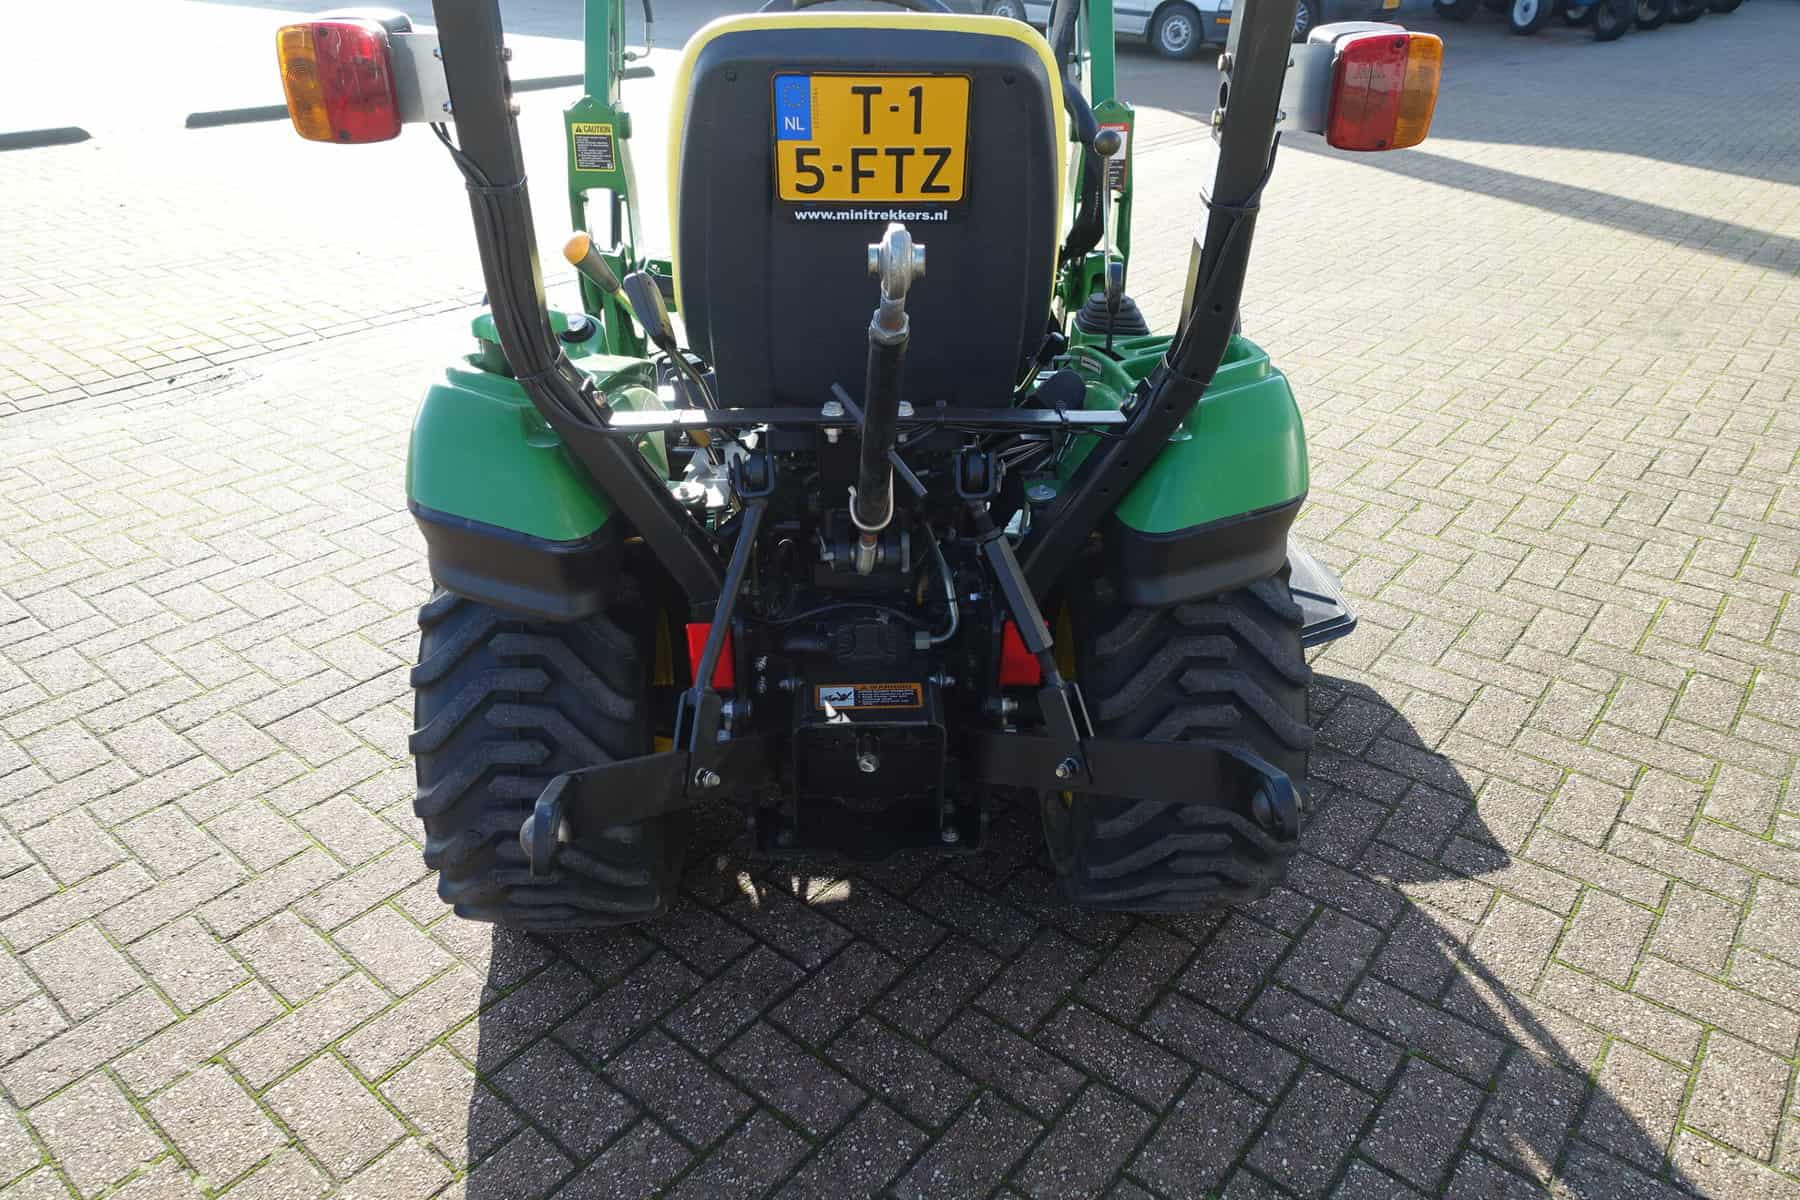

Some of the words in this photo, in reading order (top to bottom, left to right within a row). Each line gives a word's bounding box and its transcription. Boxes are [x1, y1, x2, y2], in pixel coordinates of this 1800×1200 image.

[784, 116, 805, 130] NL
[851, 86, 923, 134] T-1
[795, 147, 952, 193] 5-FTZ
[795, 209, 948, 221] www.minitrekkers.nl
